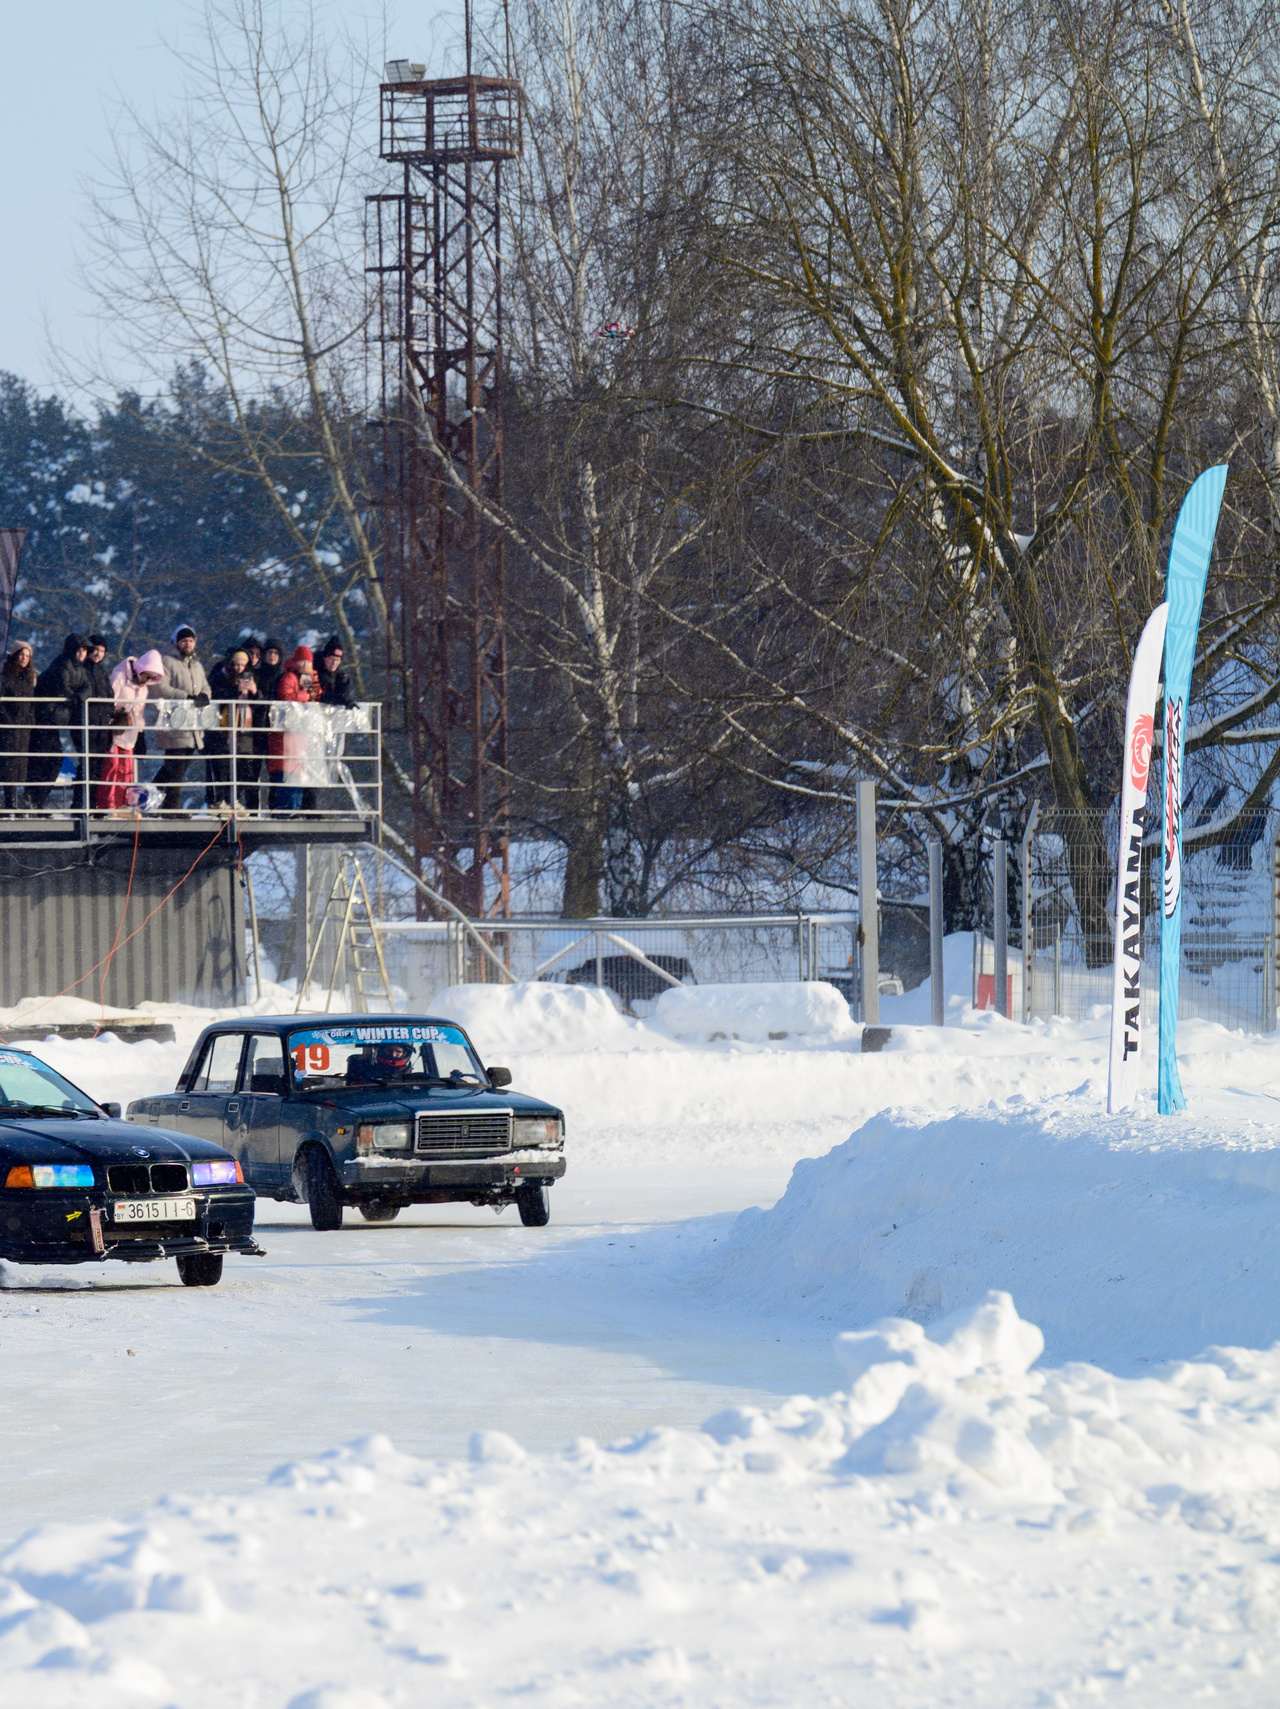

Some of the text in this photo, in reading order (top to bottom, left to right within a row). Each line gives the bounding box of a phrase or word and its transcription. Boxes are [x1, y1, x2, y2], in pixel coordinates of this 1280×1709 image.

[1122, 806, 1146, 1062] TAKAYAMA
[330, 1027, 439, 1041] DRIFT WINTER CUP
[291, 1043, 330, 1072] 19
[116, 1212, 125, 1220] BY
[128, 1202, 160, 1219] 3615
